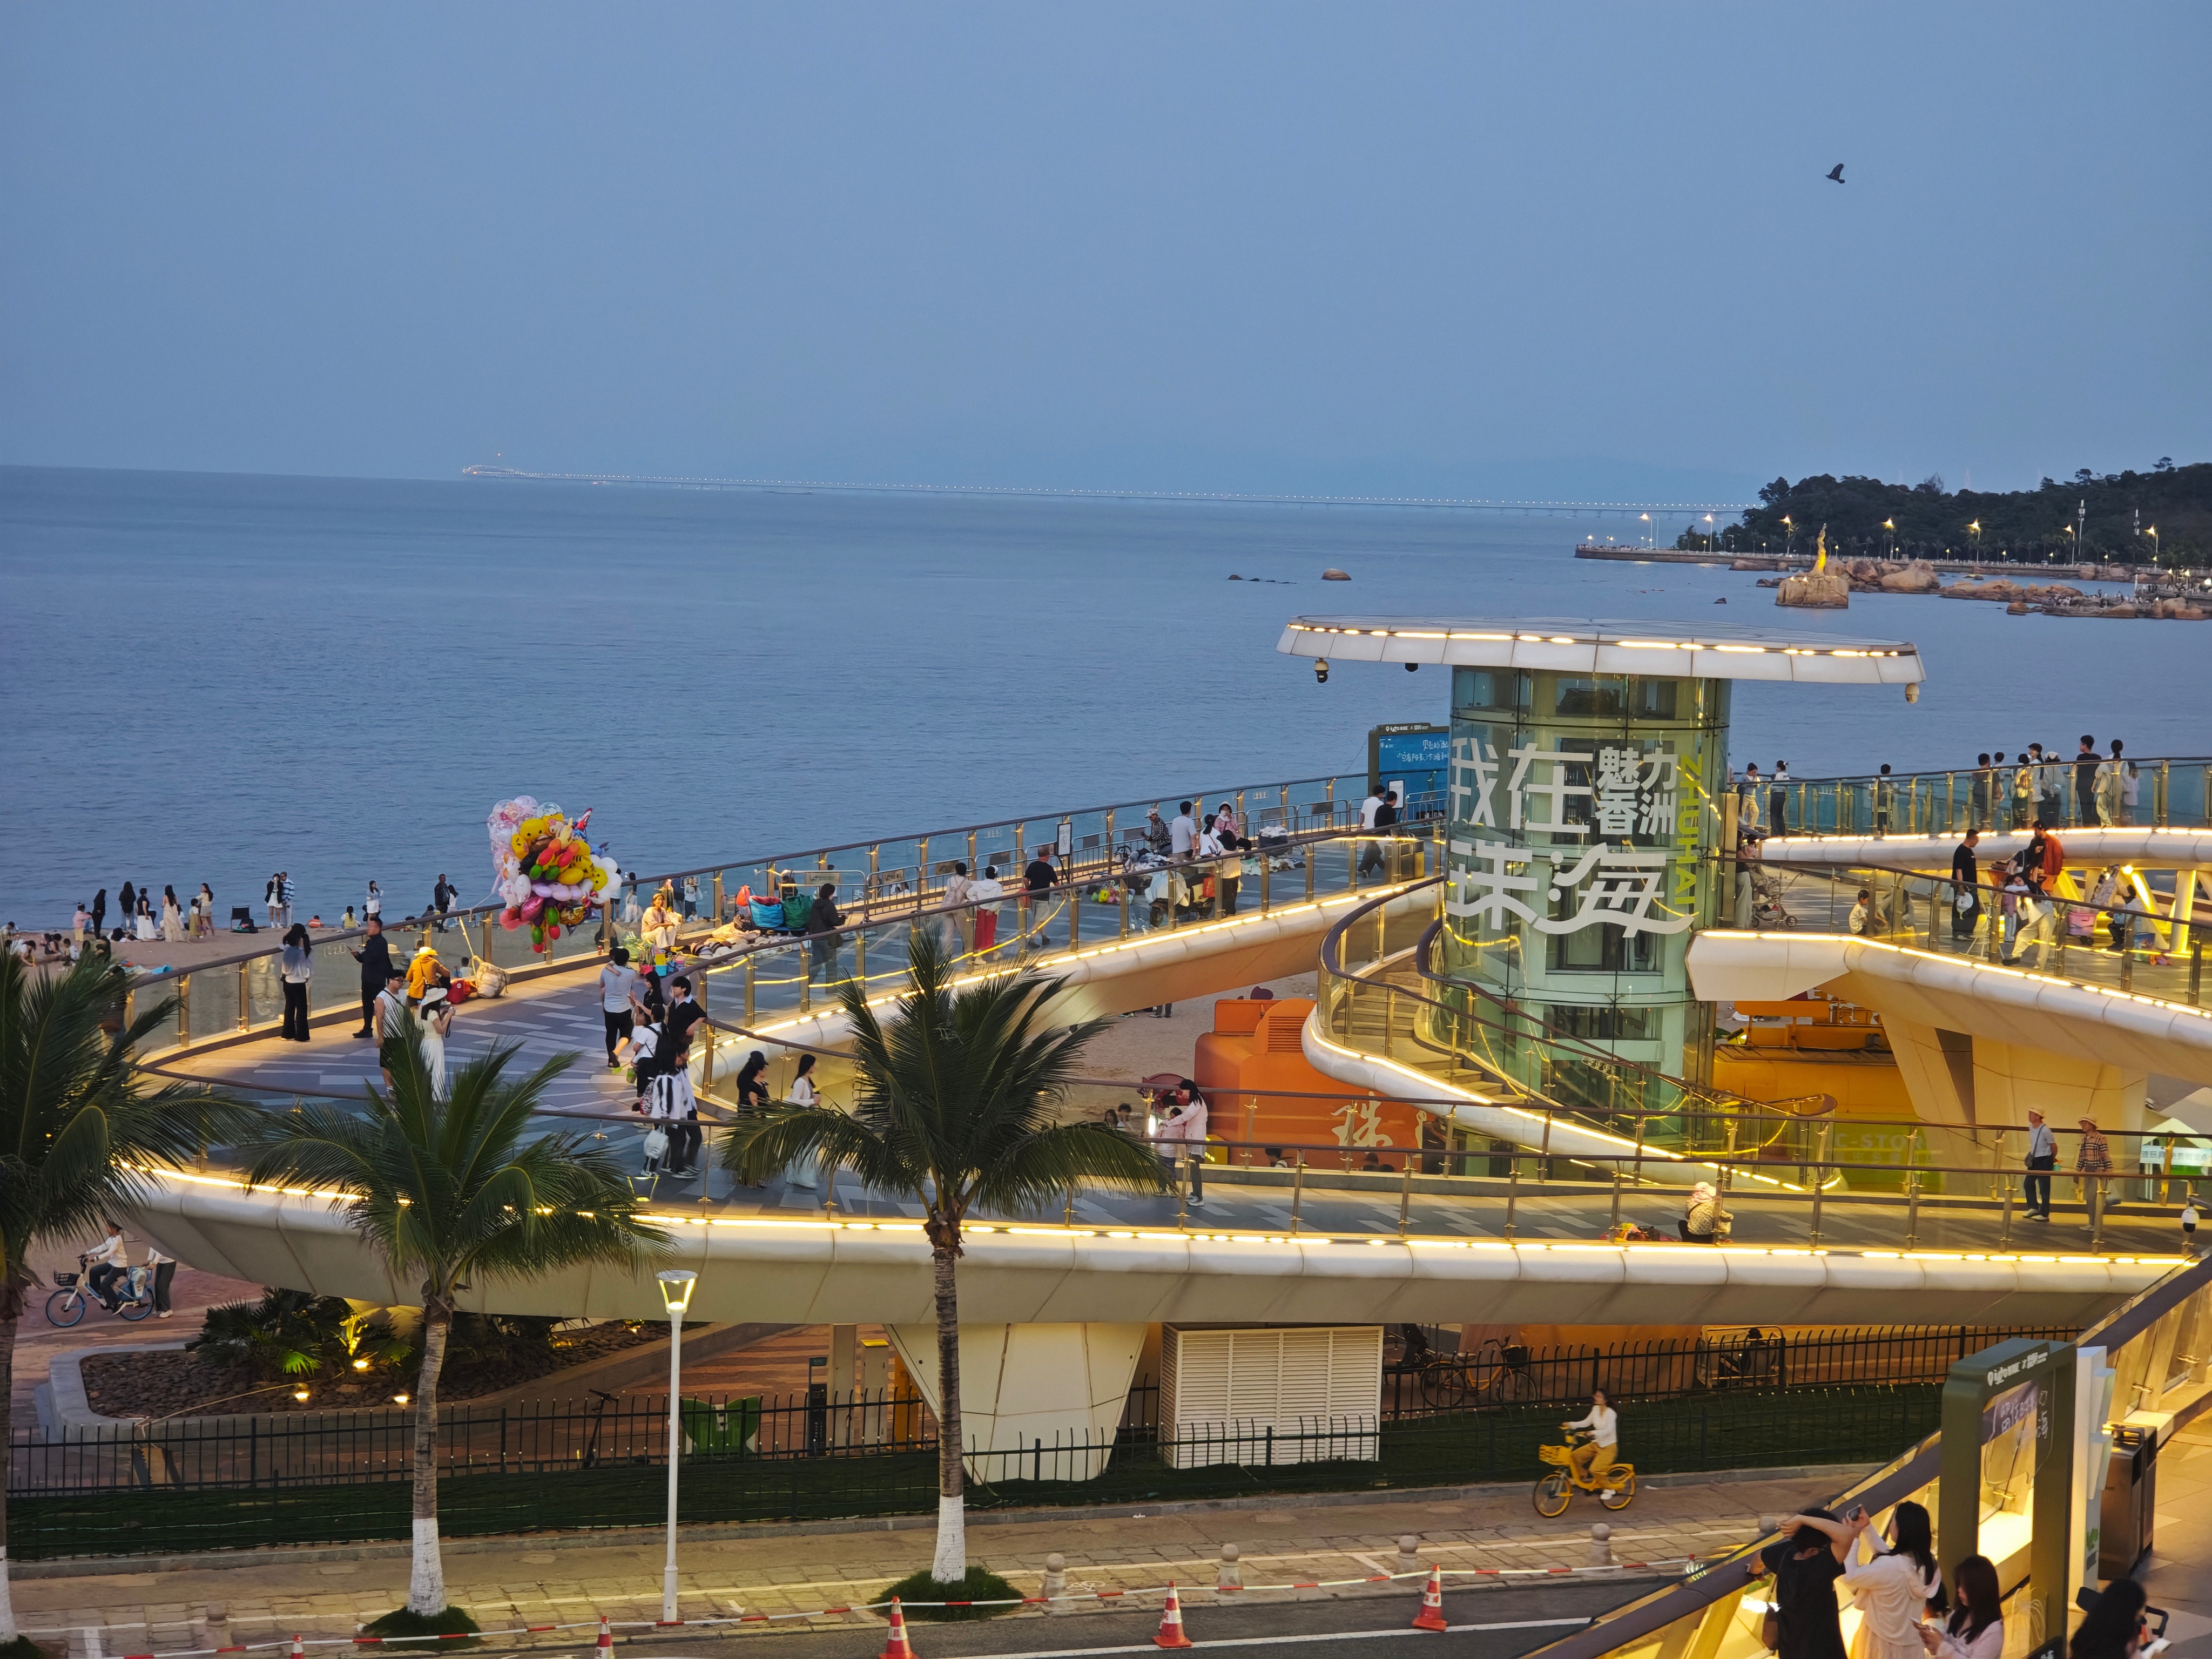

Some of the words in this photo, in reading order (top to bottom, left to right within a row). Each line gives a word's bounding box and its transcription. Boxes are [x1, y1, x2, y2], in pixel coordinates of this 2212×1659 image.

[1451, 737, 1593, 833] 我在
[1595, 792, 1676, 835] 香洲
[1596, 747, 1678, 790] 魅力
[1675, 754, 1703, 905] ZHUHAI
[1446, 839, 1695, 938] 珠海
